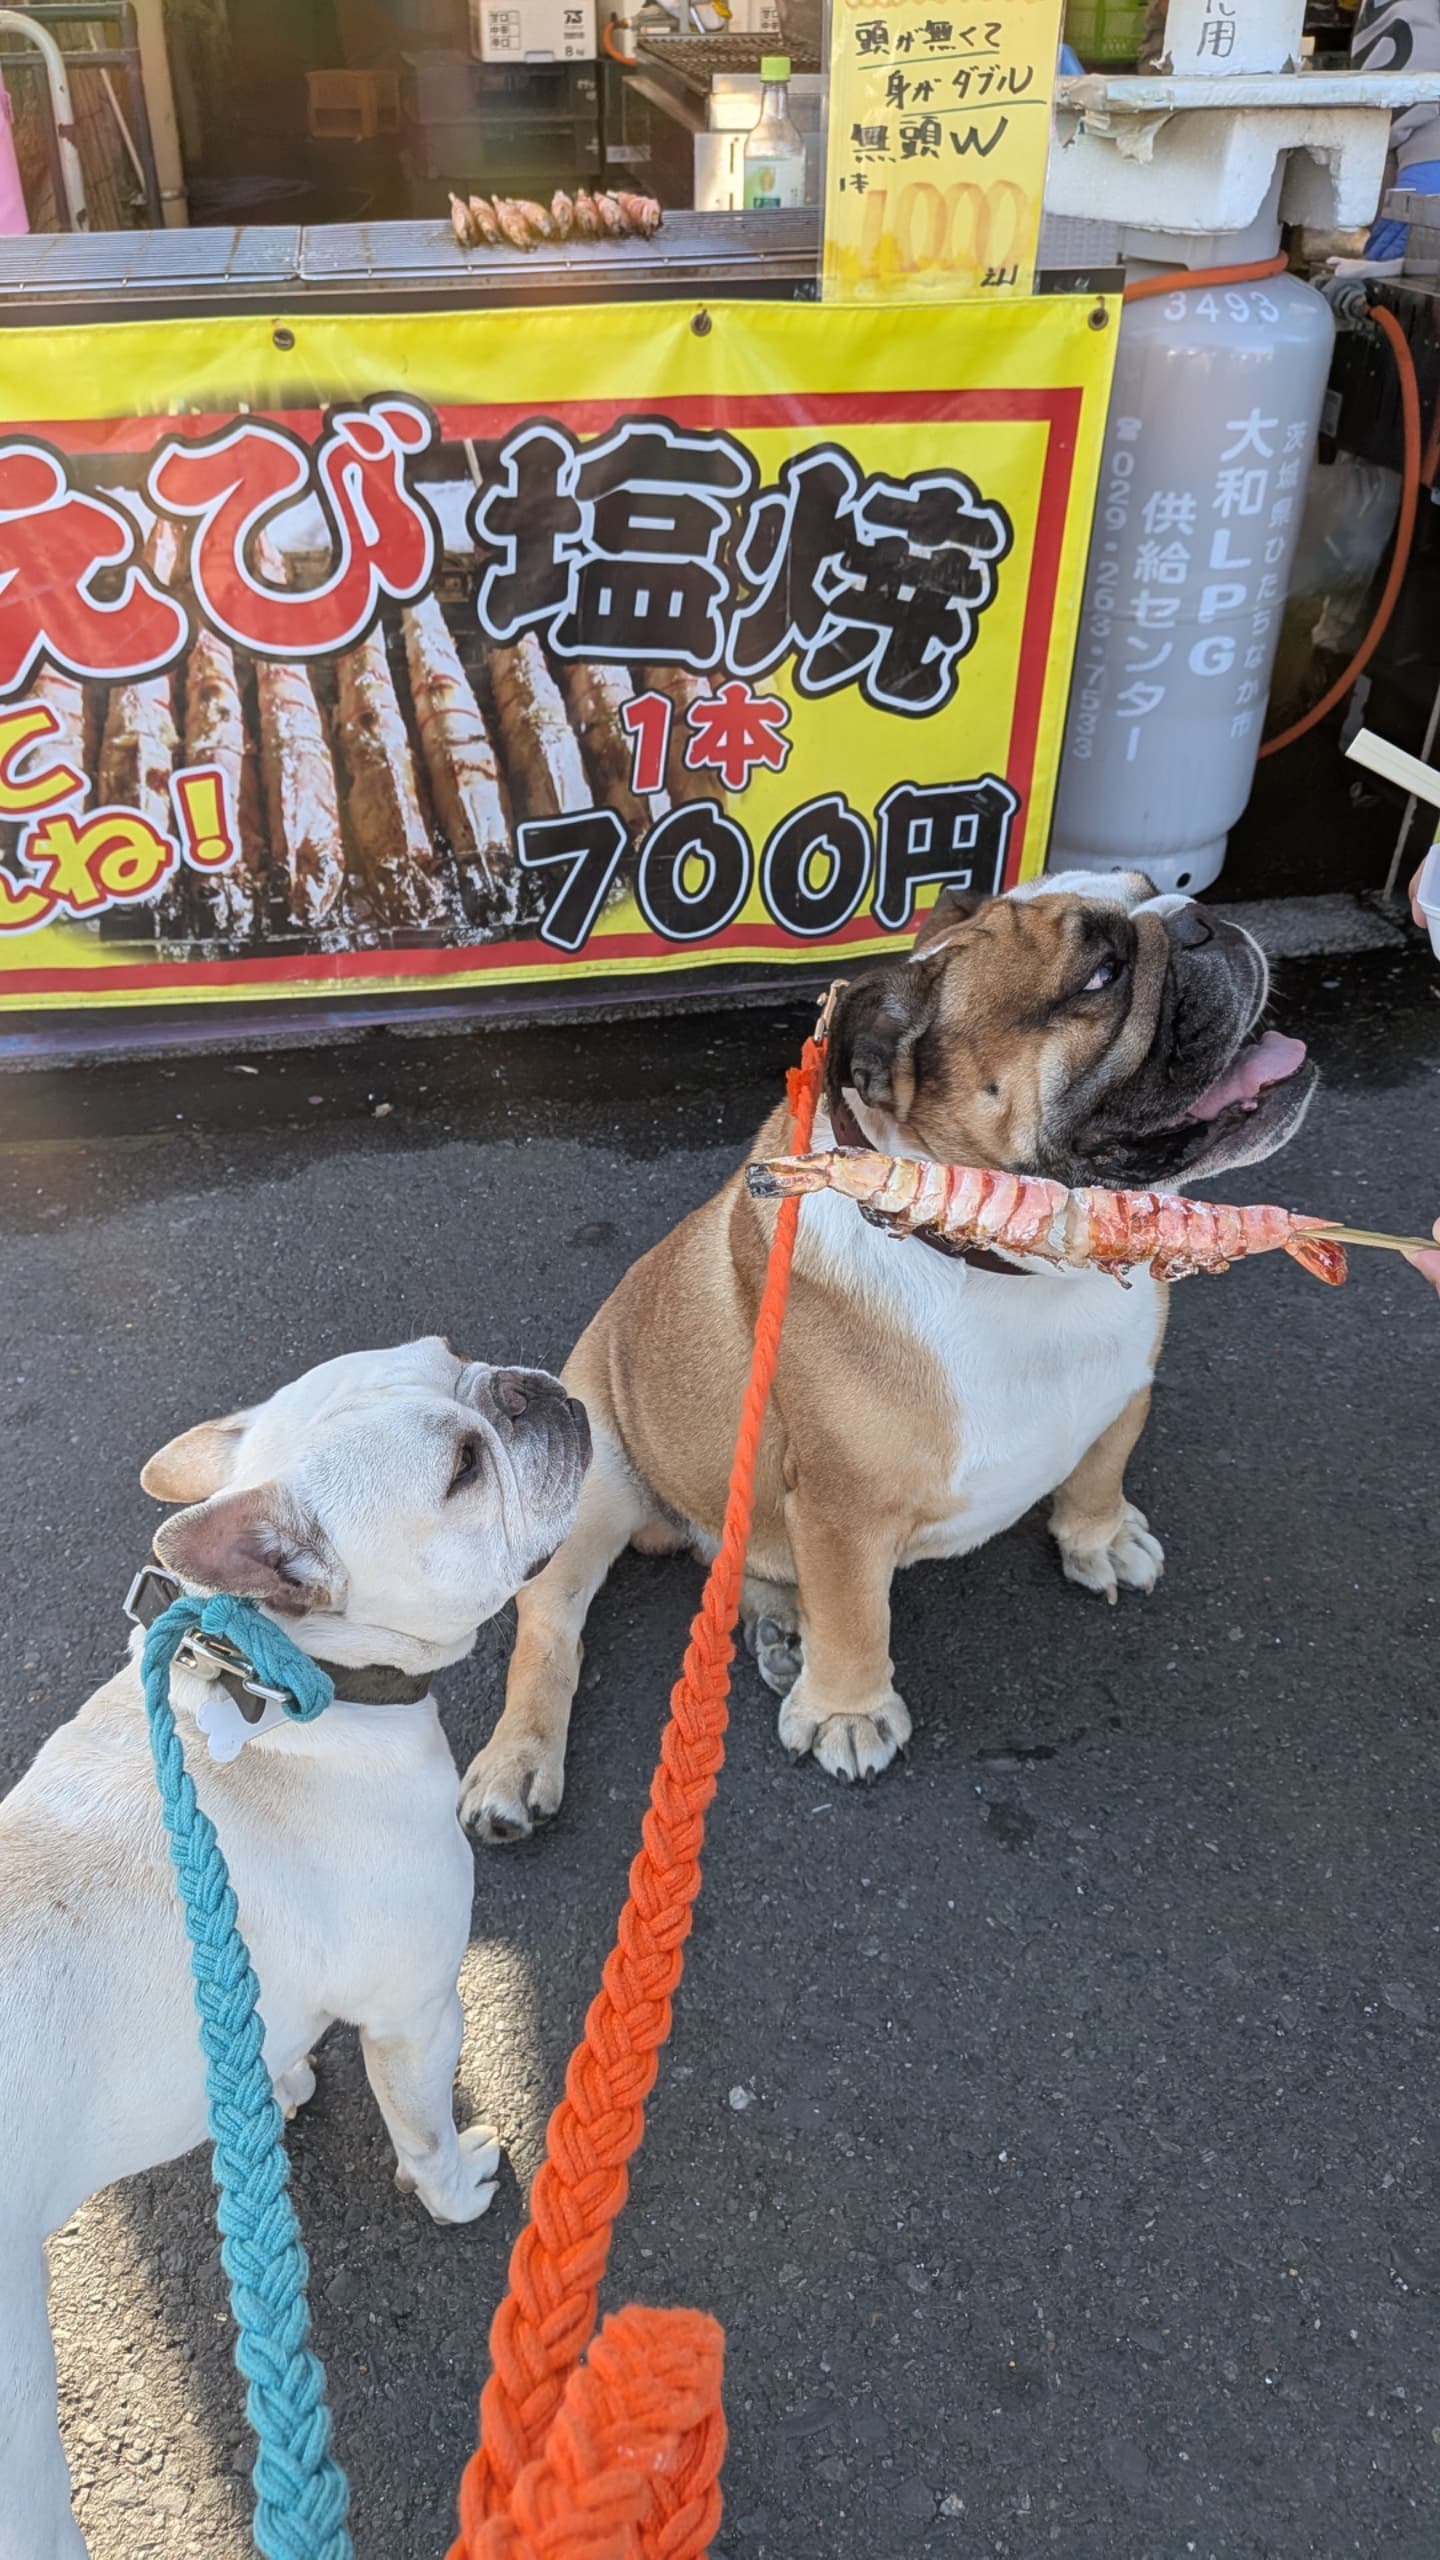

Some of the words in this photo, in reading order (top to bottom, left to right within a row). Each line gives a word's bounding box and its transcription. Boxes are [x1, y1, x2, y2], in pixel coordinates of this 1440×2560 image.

[855, 19, 1003, 56] 頭が無くて
[1163, 290, 1280, 323] 3493
[1188, 407, 1280, 677] 大和LPG
[1115, 490, 1197, 762] 供給センター
[619, 680, 792, 797] 1本
[516, 773, 1021, 953] 700円
